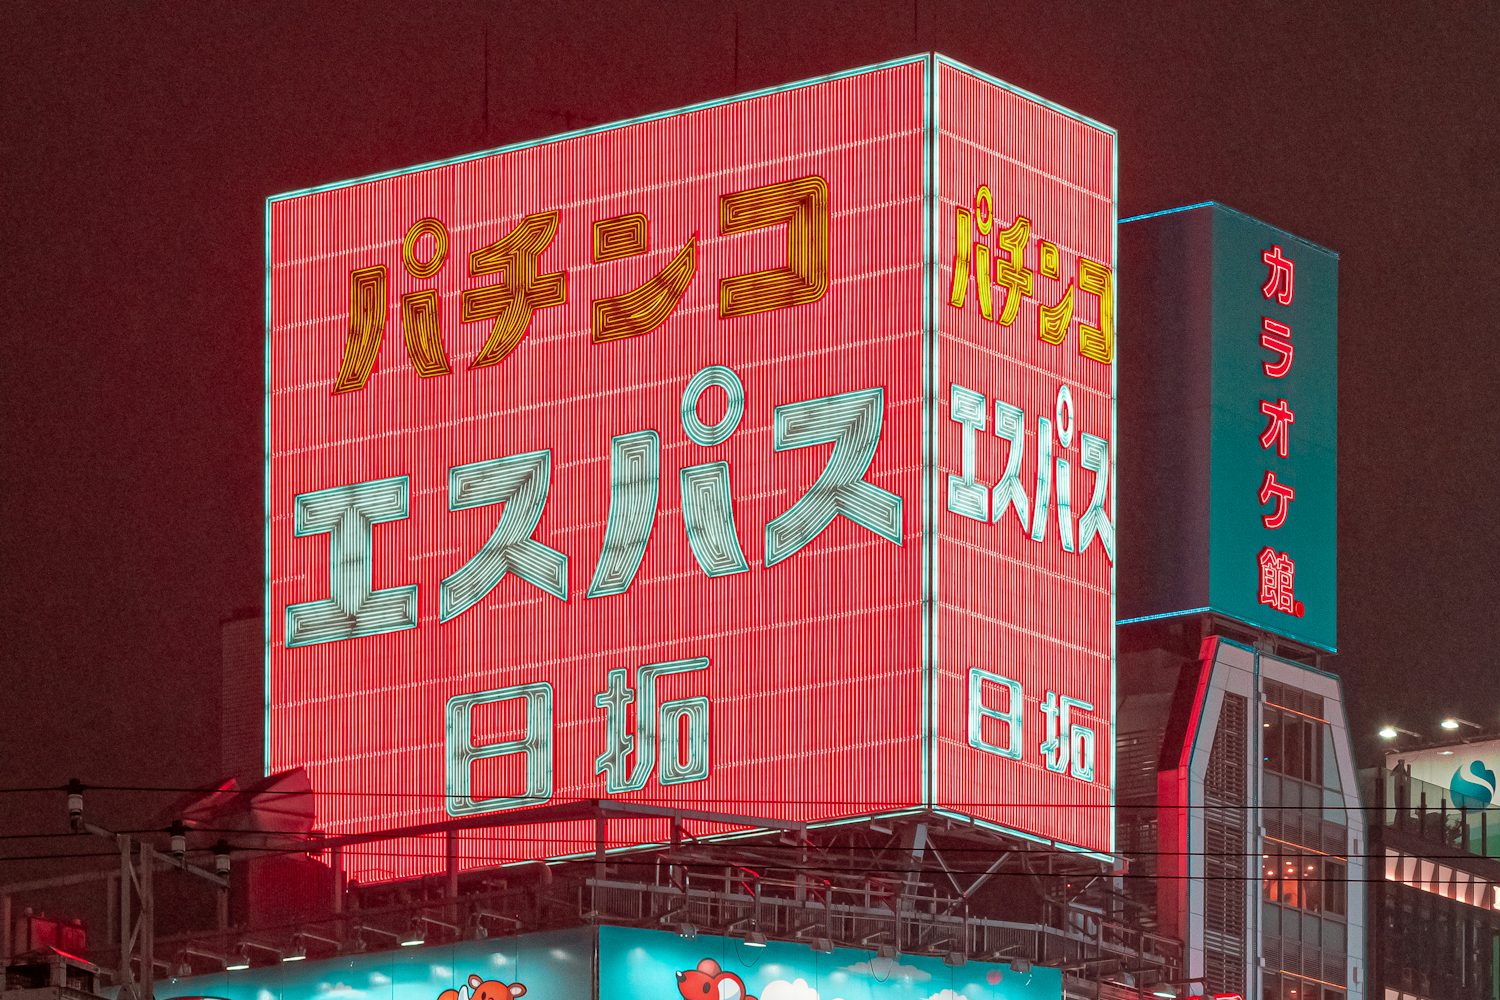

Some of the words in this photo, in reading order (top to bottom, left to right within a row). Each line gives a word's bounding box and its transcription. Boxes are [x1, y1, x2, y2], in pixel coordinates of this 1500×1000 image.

[333, 175, 828, 395] パチンコ
[950, 184, 1114, 364] パチンコ
[284, 364, 903, 649] エスパス
[948, 382, 1115, 565] エスパス
[1259, 245, 1295, 614] カラオケ館
